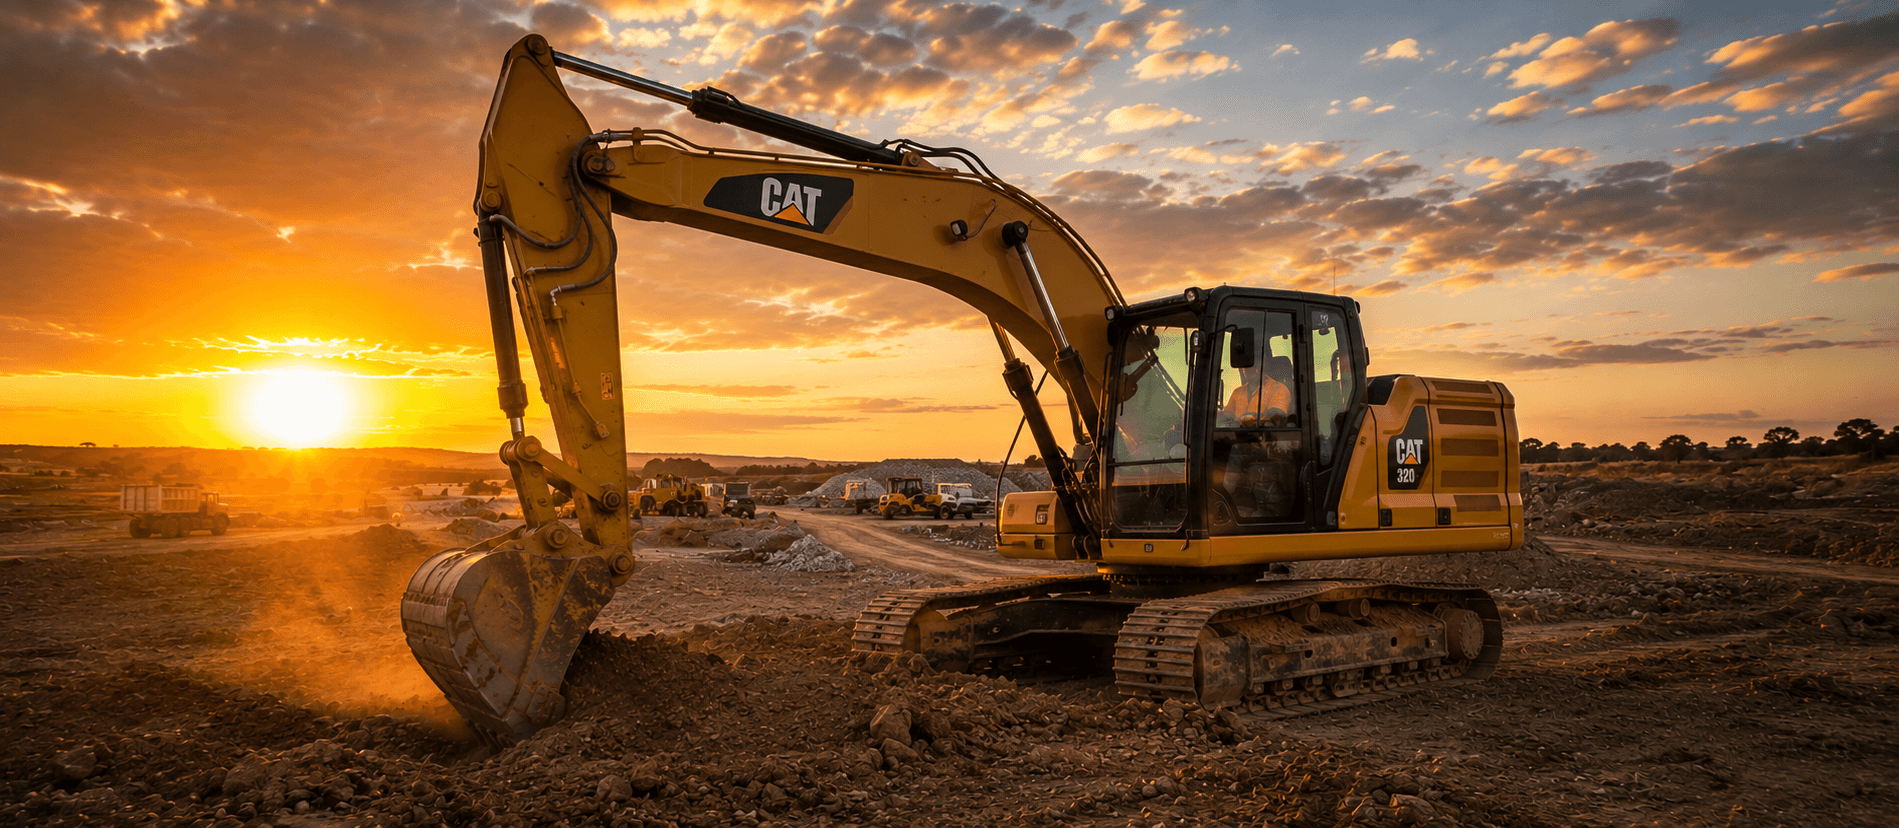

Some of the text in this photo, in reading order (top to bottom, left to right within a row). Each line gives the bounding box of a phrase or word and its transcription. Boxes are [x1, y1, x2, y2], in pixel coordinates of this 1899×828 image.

[761, 177, 822, 226] CAT
[1396, 438, 1423, 464] CAT
[1397, 468, 1415, 483] 320
